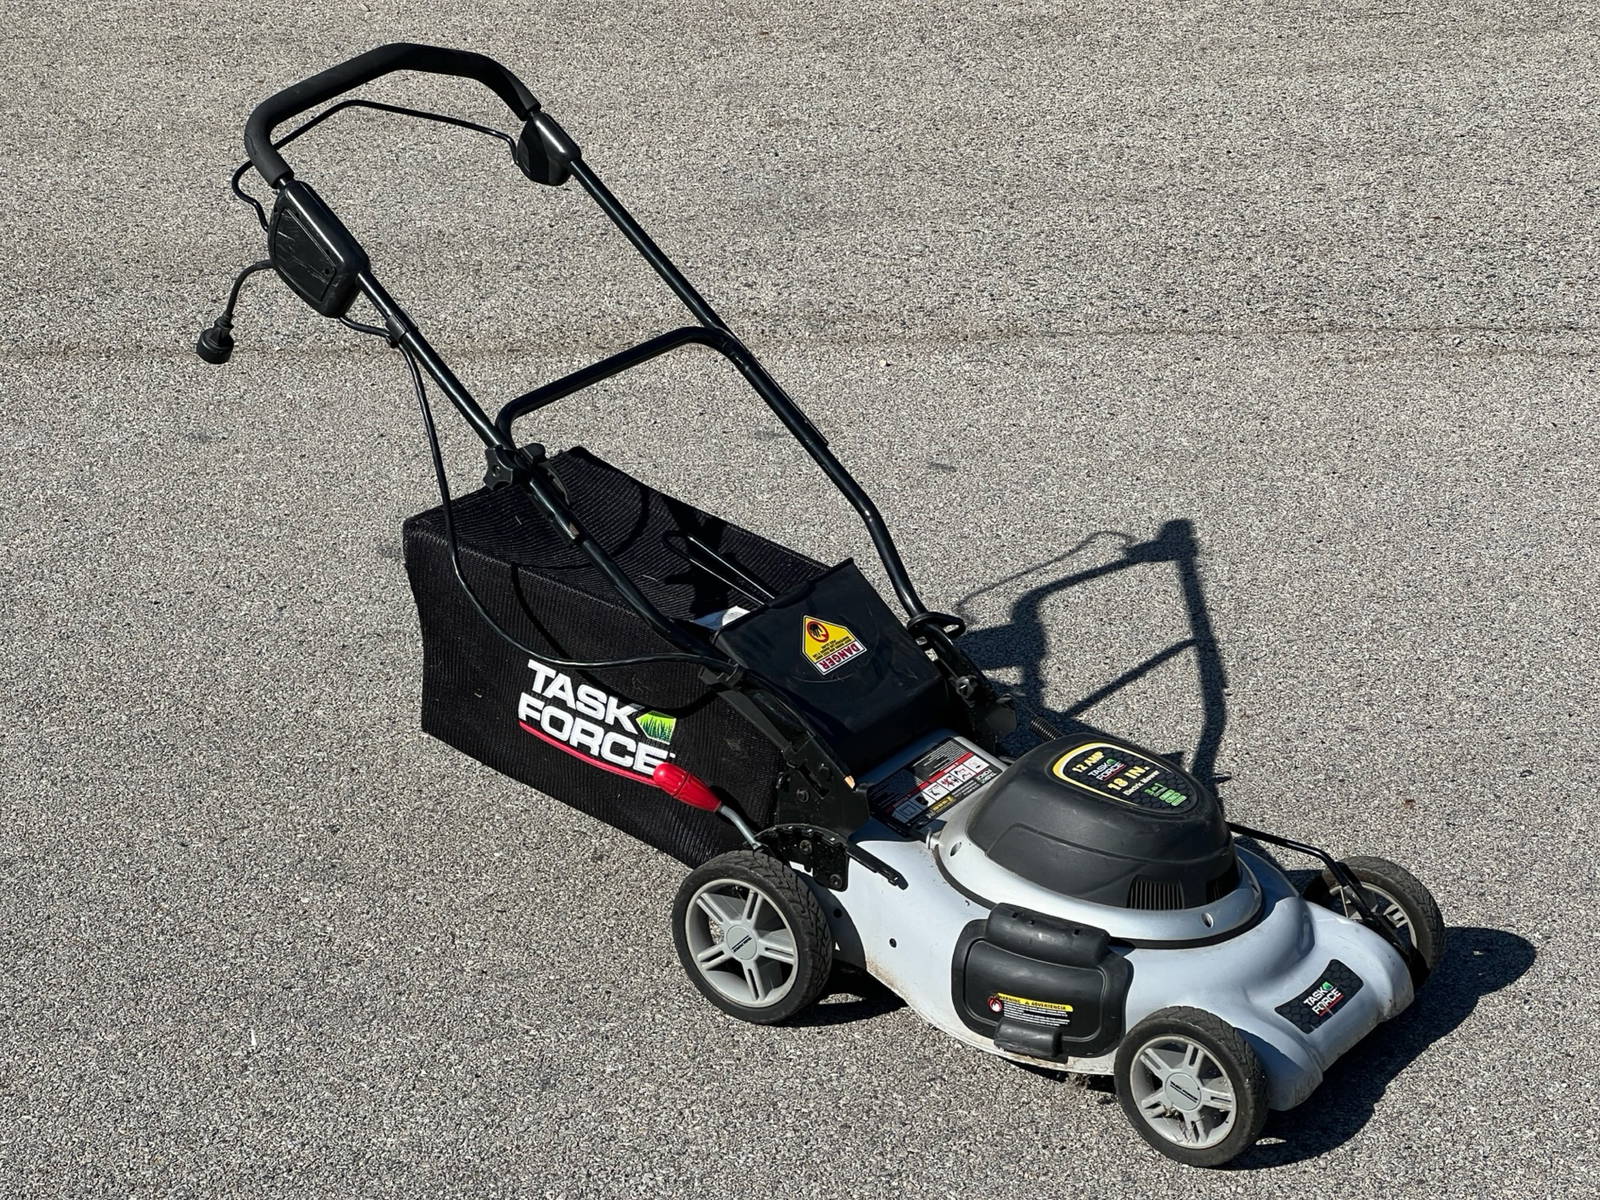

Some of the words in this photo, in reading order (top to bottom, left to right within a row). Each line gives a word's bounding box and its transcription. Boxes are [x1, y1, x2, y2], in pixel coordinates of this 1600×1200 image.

[819, 643, 861, 670] DANGER
[527, 659, 642, 735] TASK
[518, 692, 668, 776] FORCE
[1072, 763, 1088, 773] 12
[1088, 763, 1108, 776] TASK
[1107, 778, 1128, 791] 18
[1124, 766, 1150, 779] IN.
[1303, 986, 1328, 1007] TASK
[1311, 987, 1341, 1015] FORCE
